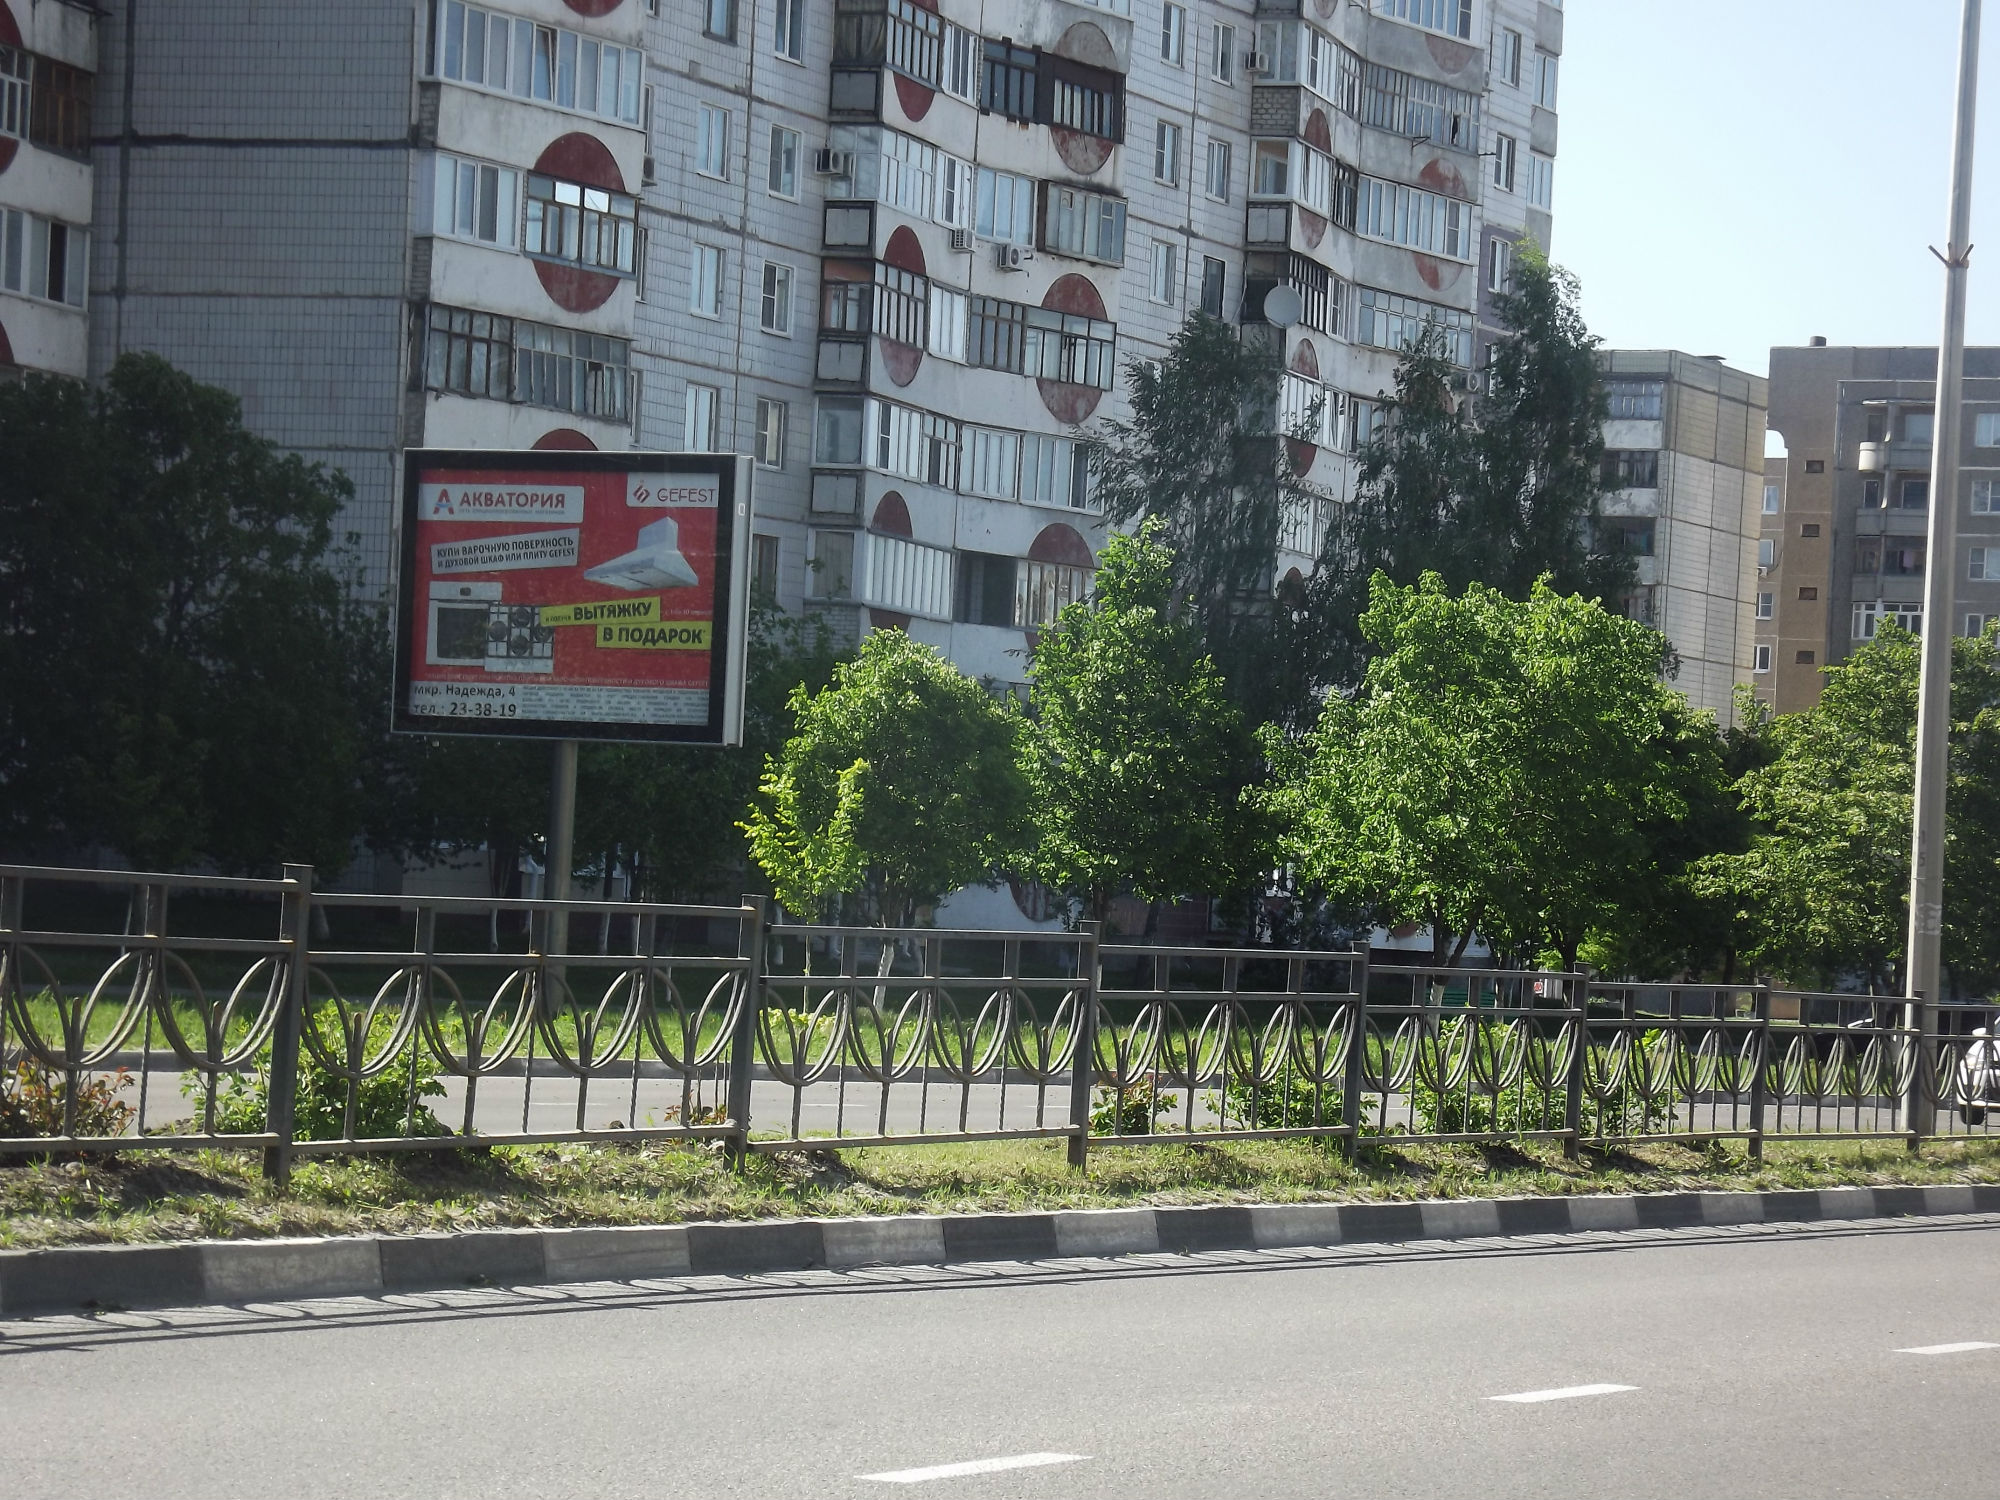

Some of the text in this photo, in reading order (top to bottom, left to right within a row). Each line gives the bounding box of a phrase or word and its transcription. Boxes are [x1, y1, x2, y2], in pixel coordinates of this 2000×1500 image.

[459, 491, 565, 509] АКВАТОРИЯ
[657, 488, 716, 502] GEFEST
[437, 537, 574, 558] КУПИ ВАРОЧНУЮ ПОВЕРХНОСТЬ
[445, 556, 479, 568] ДУХОВОЙ
[481, 554, 504, 564] ШКАФ
[505, 552, 521, 562] ИЛИ
[523, 550, 548, 560] ПЛИТУ
[549, 547, 575, 558] GEFEST
[573, 602, 652, 621] ВЫТЯЖКУ
[603, 627, 613, 642] В
[414, 684, 516, 698] мкр. Надежда, 4
[449, 702, 517, 717] 23-38-19
